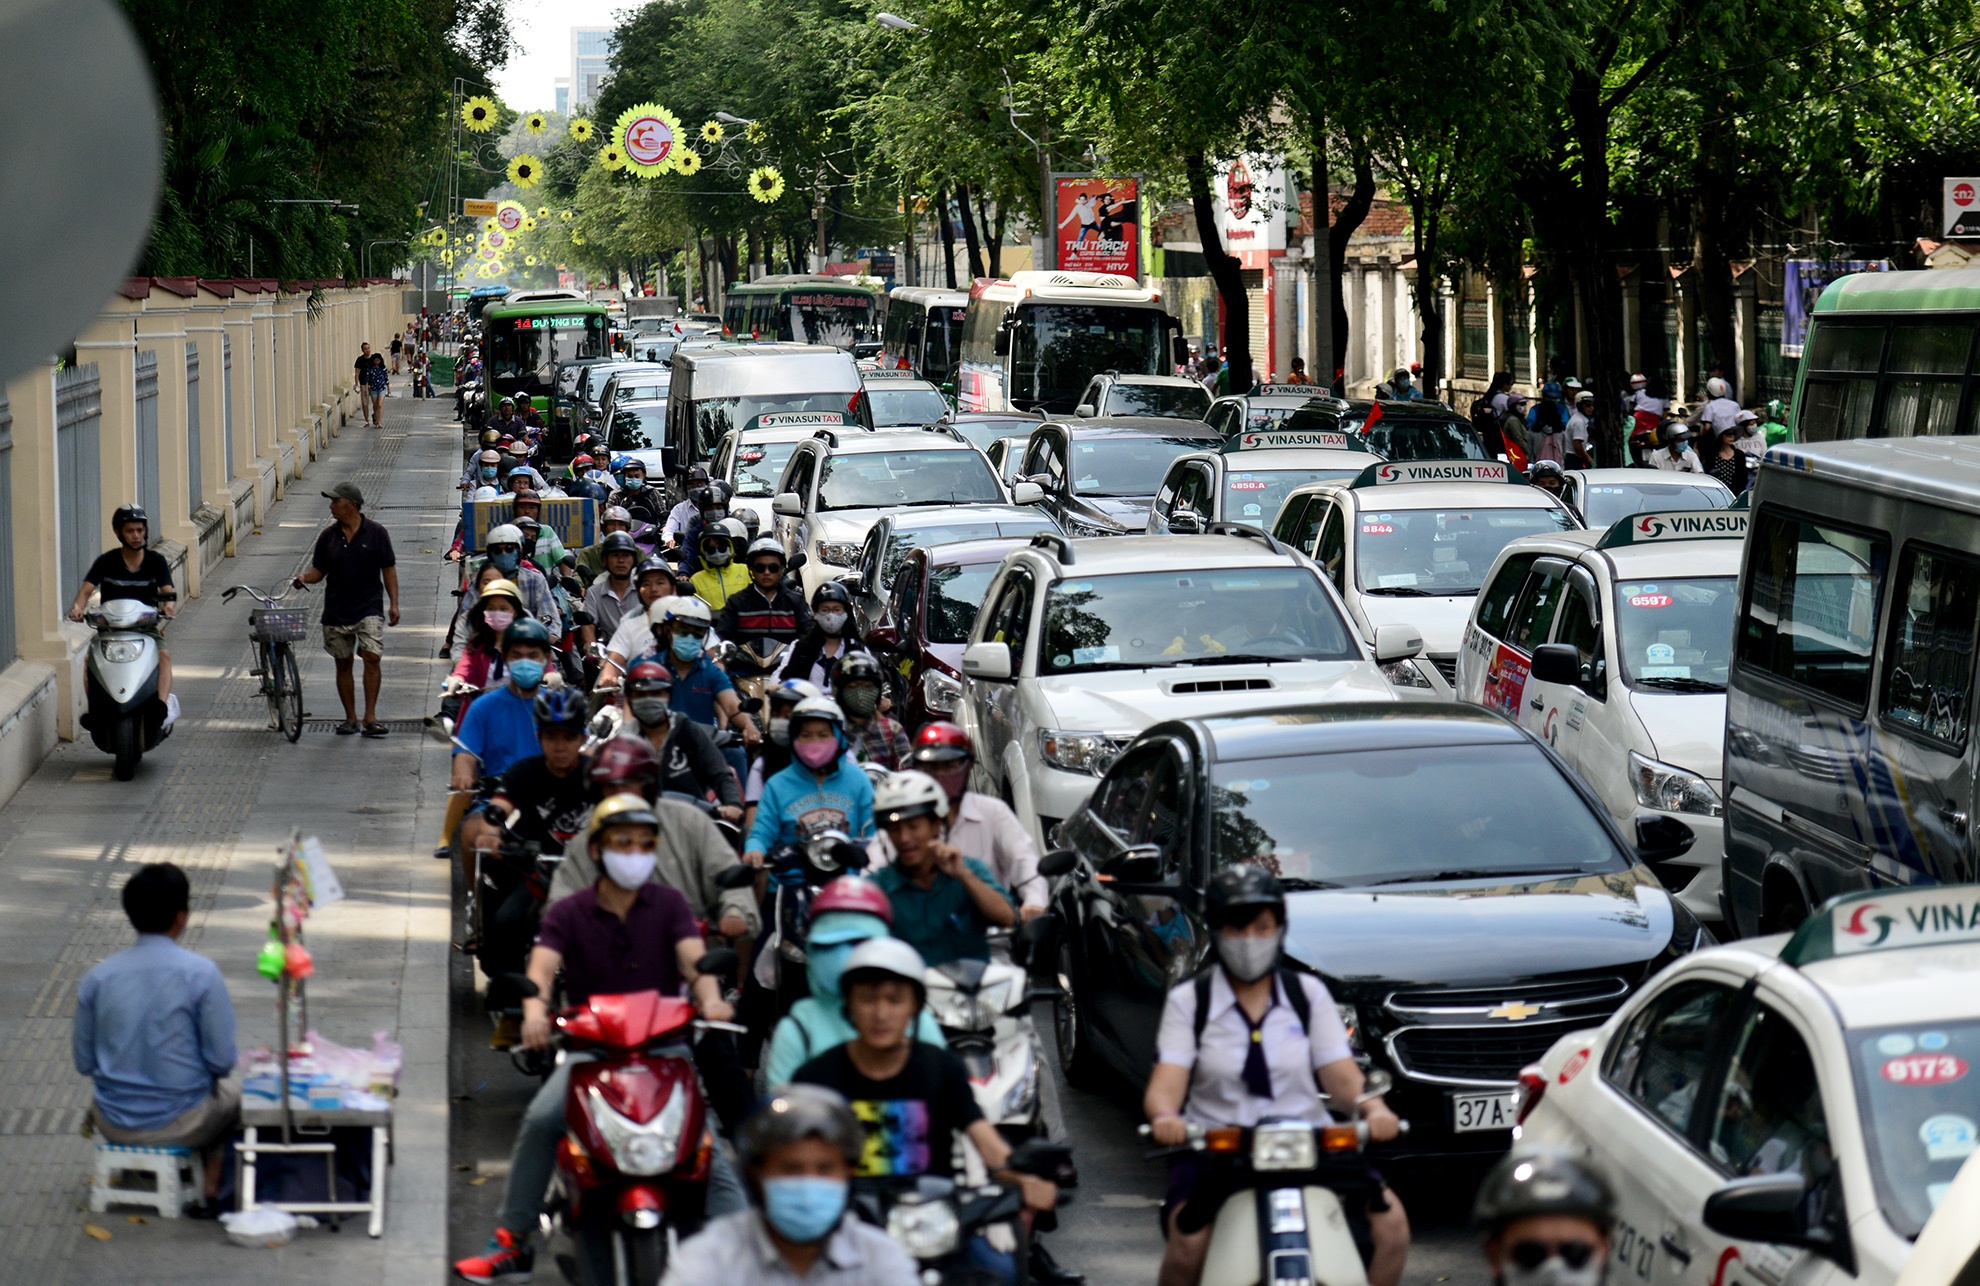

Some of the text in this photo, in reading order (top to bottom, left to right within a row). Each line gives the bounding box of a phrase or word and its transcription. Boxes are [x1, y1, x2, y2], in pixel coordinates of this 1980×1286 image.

[1106, 263, 1130, 271] HTV7
[1277, 386, 1329, 396] VINASUN TAXI
[778, 414, 841, 424] VINASUN TAXI
[1267, 434, 1346, 445] VINASUN TAXI
[1408, 466, 1505, 479] VINASUN TAXI
[1363, 525, 1393, 534] 8844
[1670, 517, 1748, 532] VINASUN
[1631, 595, 1668, 606] 6597
[1887, 1056, 1958, 1083] 9173
